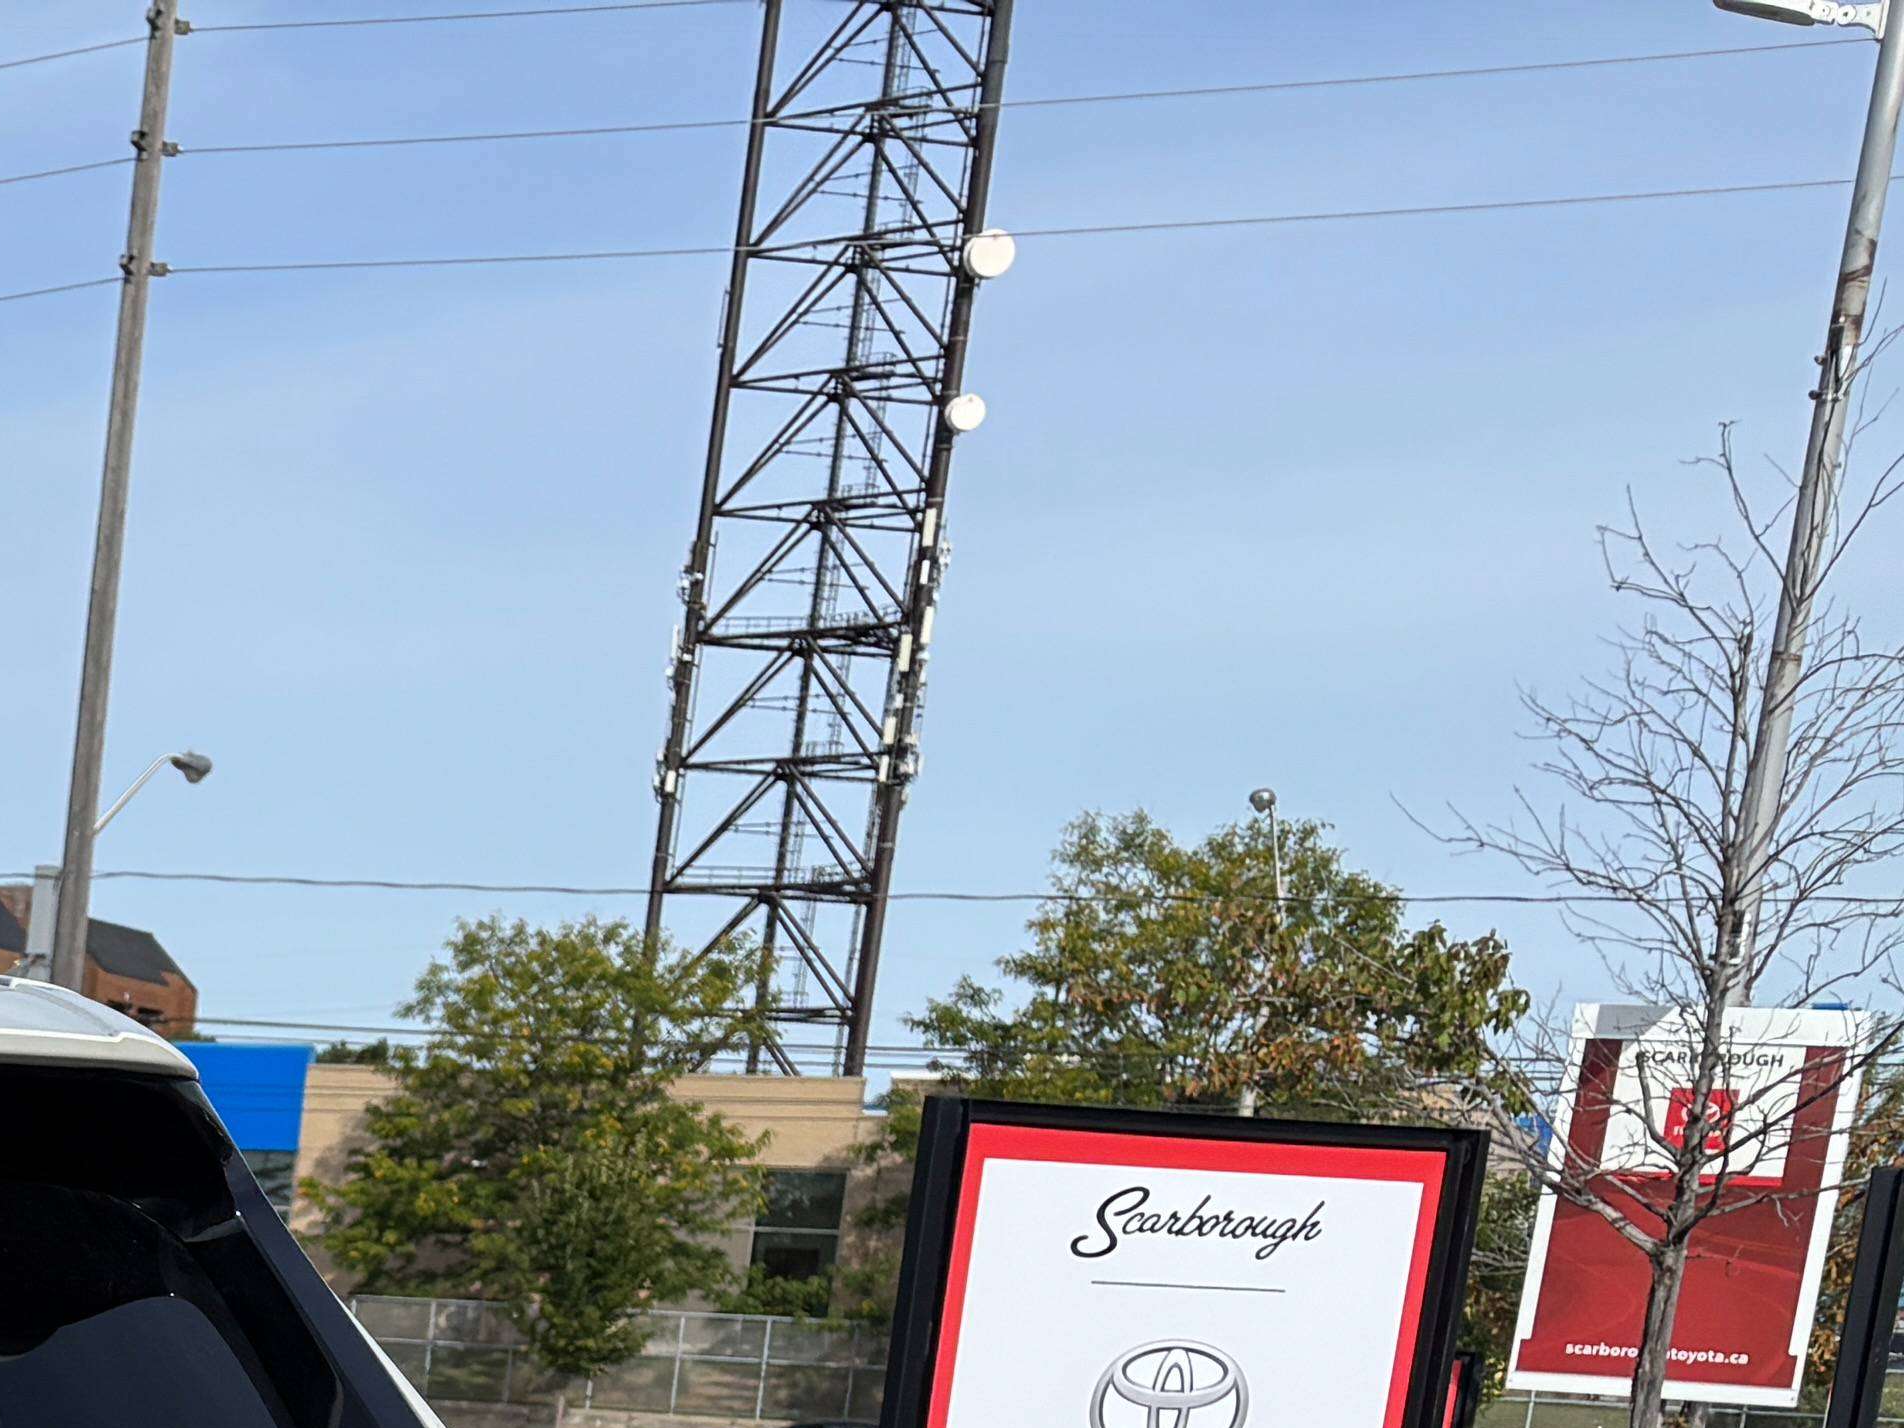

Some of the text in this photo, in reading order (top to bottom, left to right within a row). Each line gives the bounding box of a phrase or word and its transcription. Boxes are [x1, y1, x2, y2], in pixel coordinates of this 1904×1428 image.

[1642, 1051, 1784, 1068] SCAROUGH
[1069, 1185, 1327, 1261] Scarborough
[1565, 1342, 1749, 1366] scarborotoyota.ca
